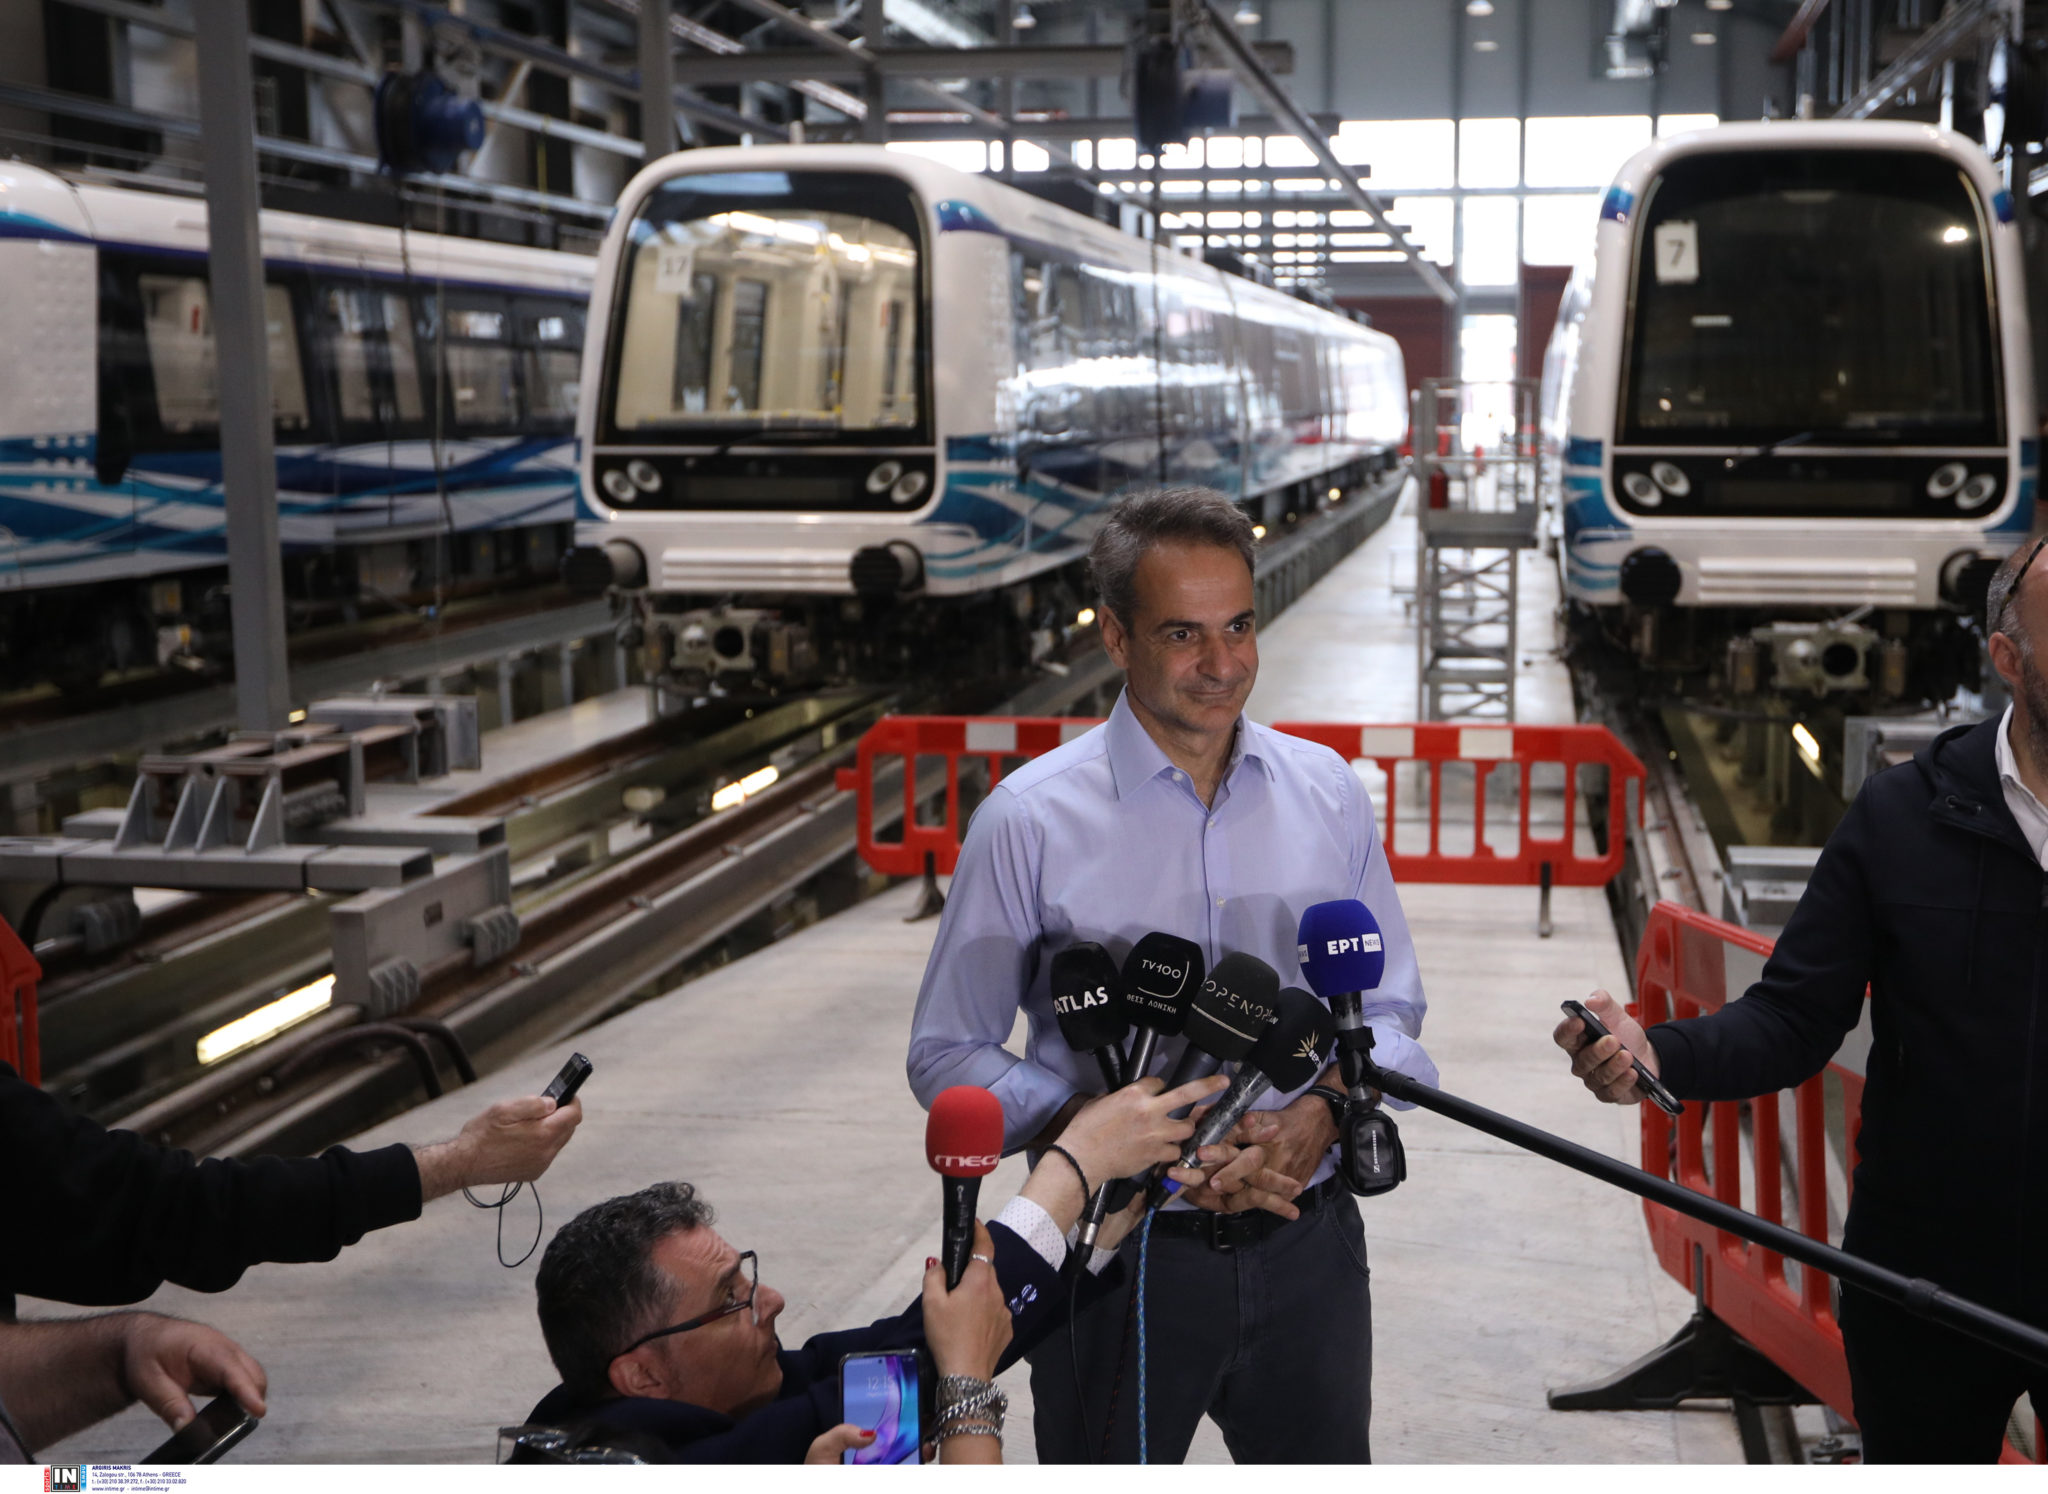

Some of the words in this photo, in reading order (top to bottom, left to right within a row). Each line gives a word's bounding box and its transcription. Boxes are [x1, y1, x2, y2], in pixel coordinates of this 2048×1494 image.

[665, 256, 688, 275] 17
[1666, 239, 1686, 269] 7
[1141, 959, 1181, 979] TV100
[1053, 986, 1109, 1015] ATLAS
[1205, 980, 1254, 1016] OPEN
